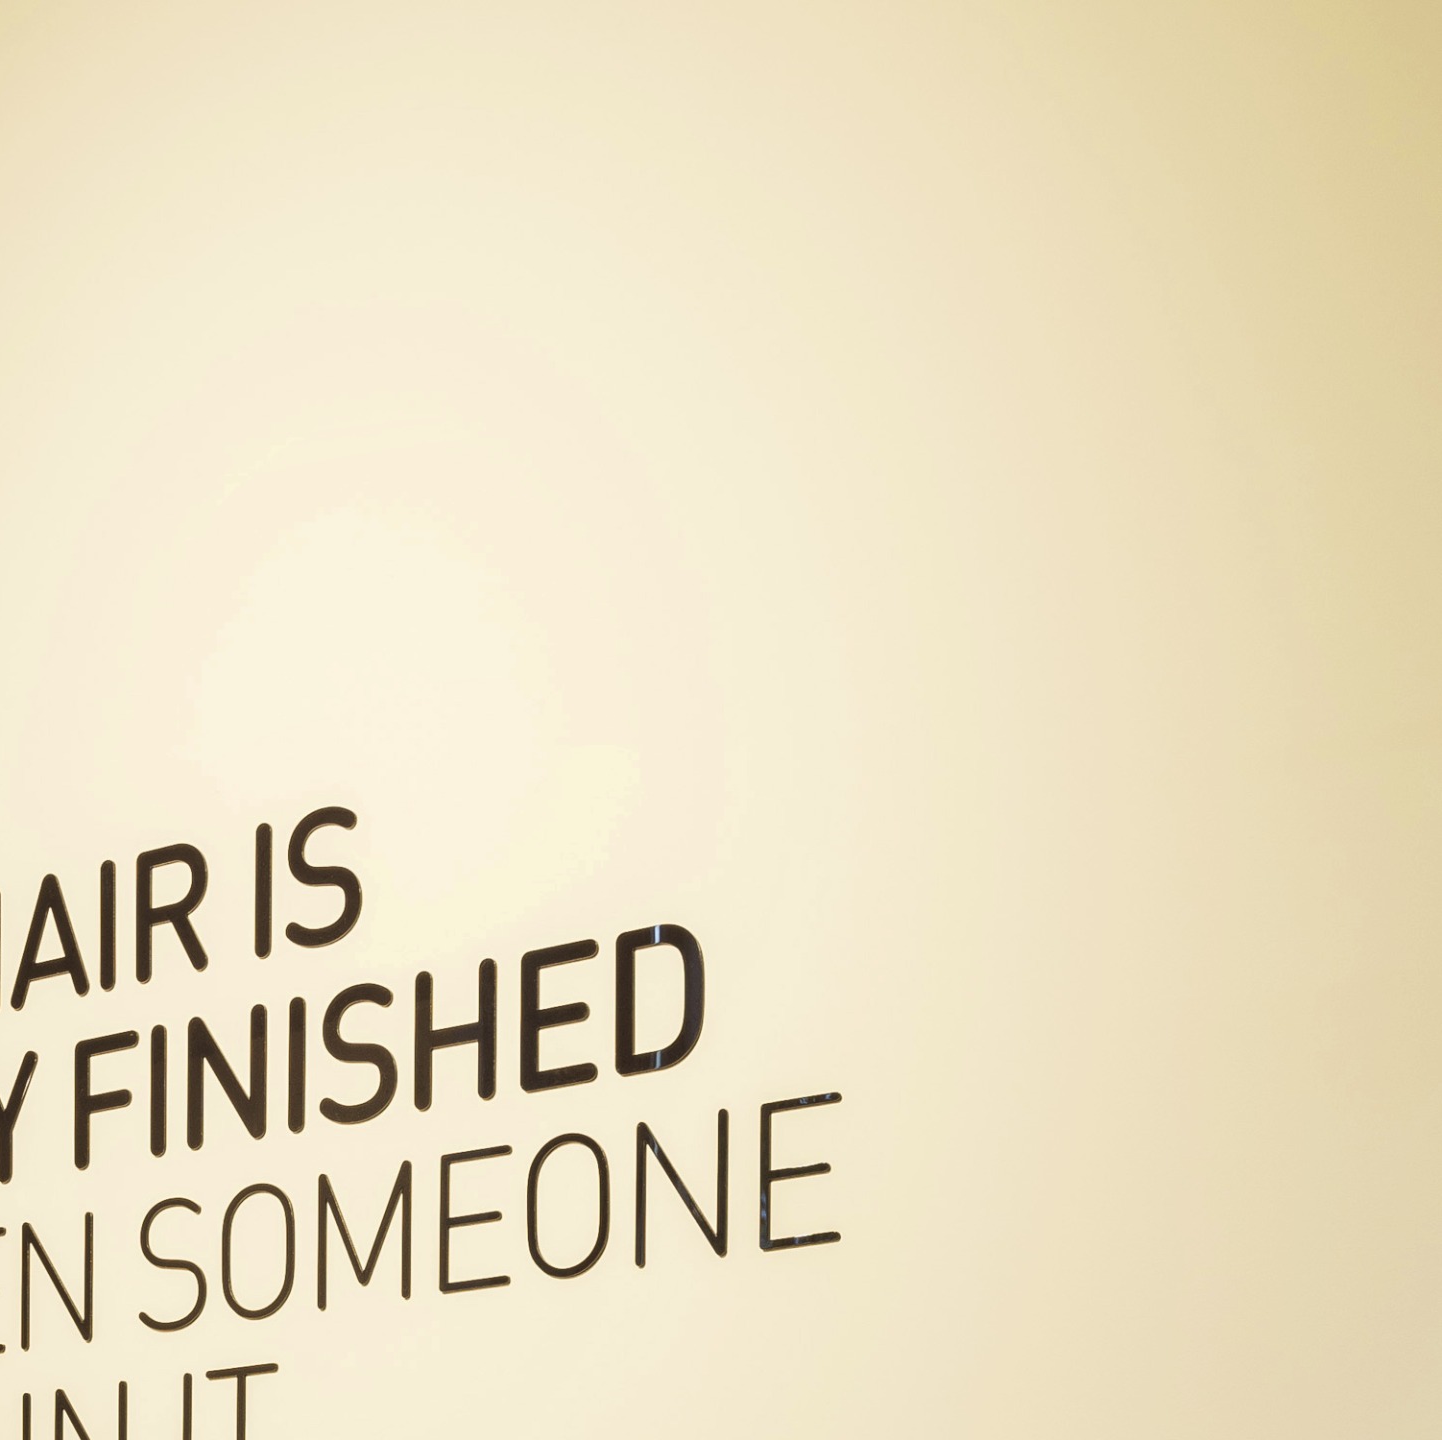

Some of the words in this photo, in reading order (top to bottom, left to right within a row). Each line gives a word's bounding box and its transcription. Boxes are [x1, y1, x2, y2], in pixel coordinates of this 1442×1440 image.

[254, 806, 364, 959] IS
[74, 924, 706, 1171] FINISHED
[138, 1092, 844, 1333] SOMEONE
